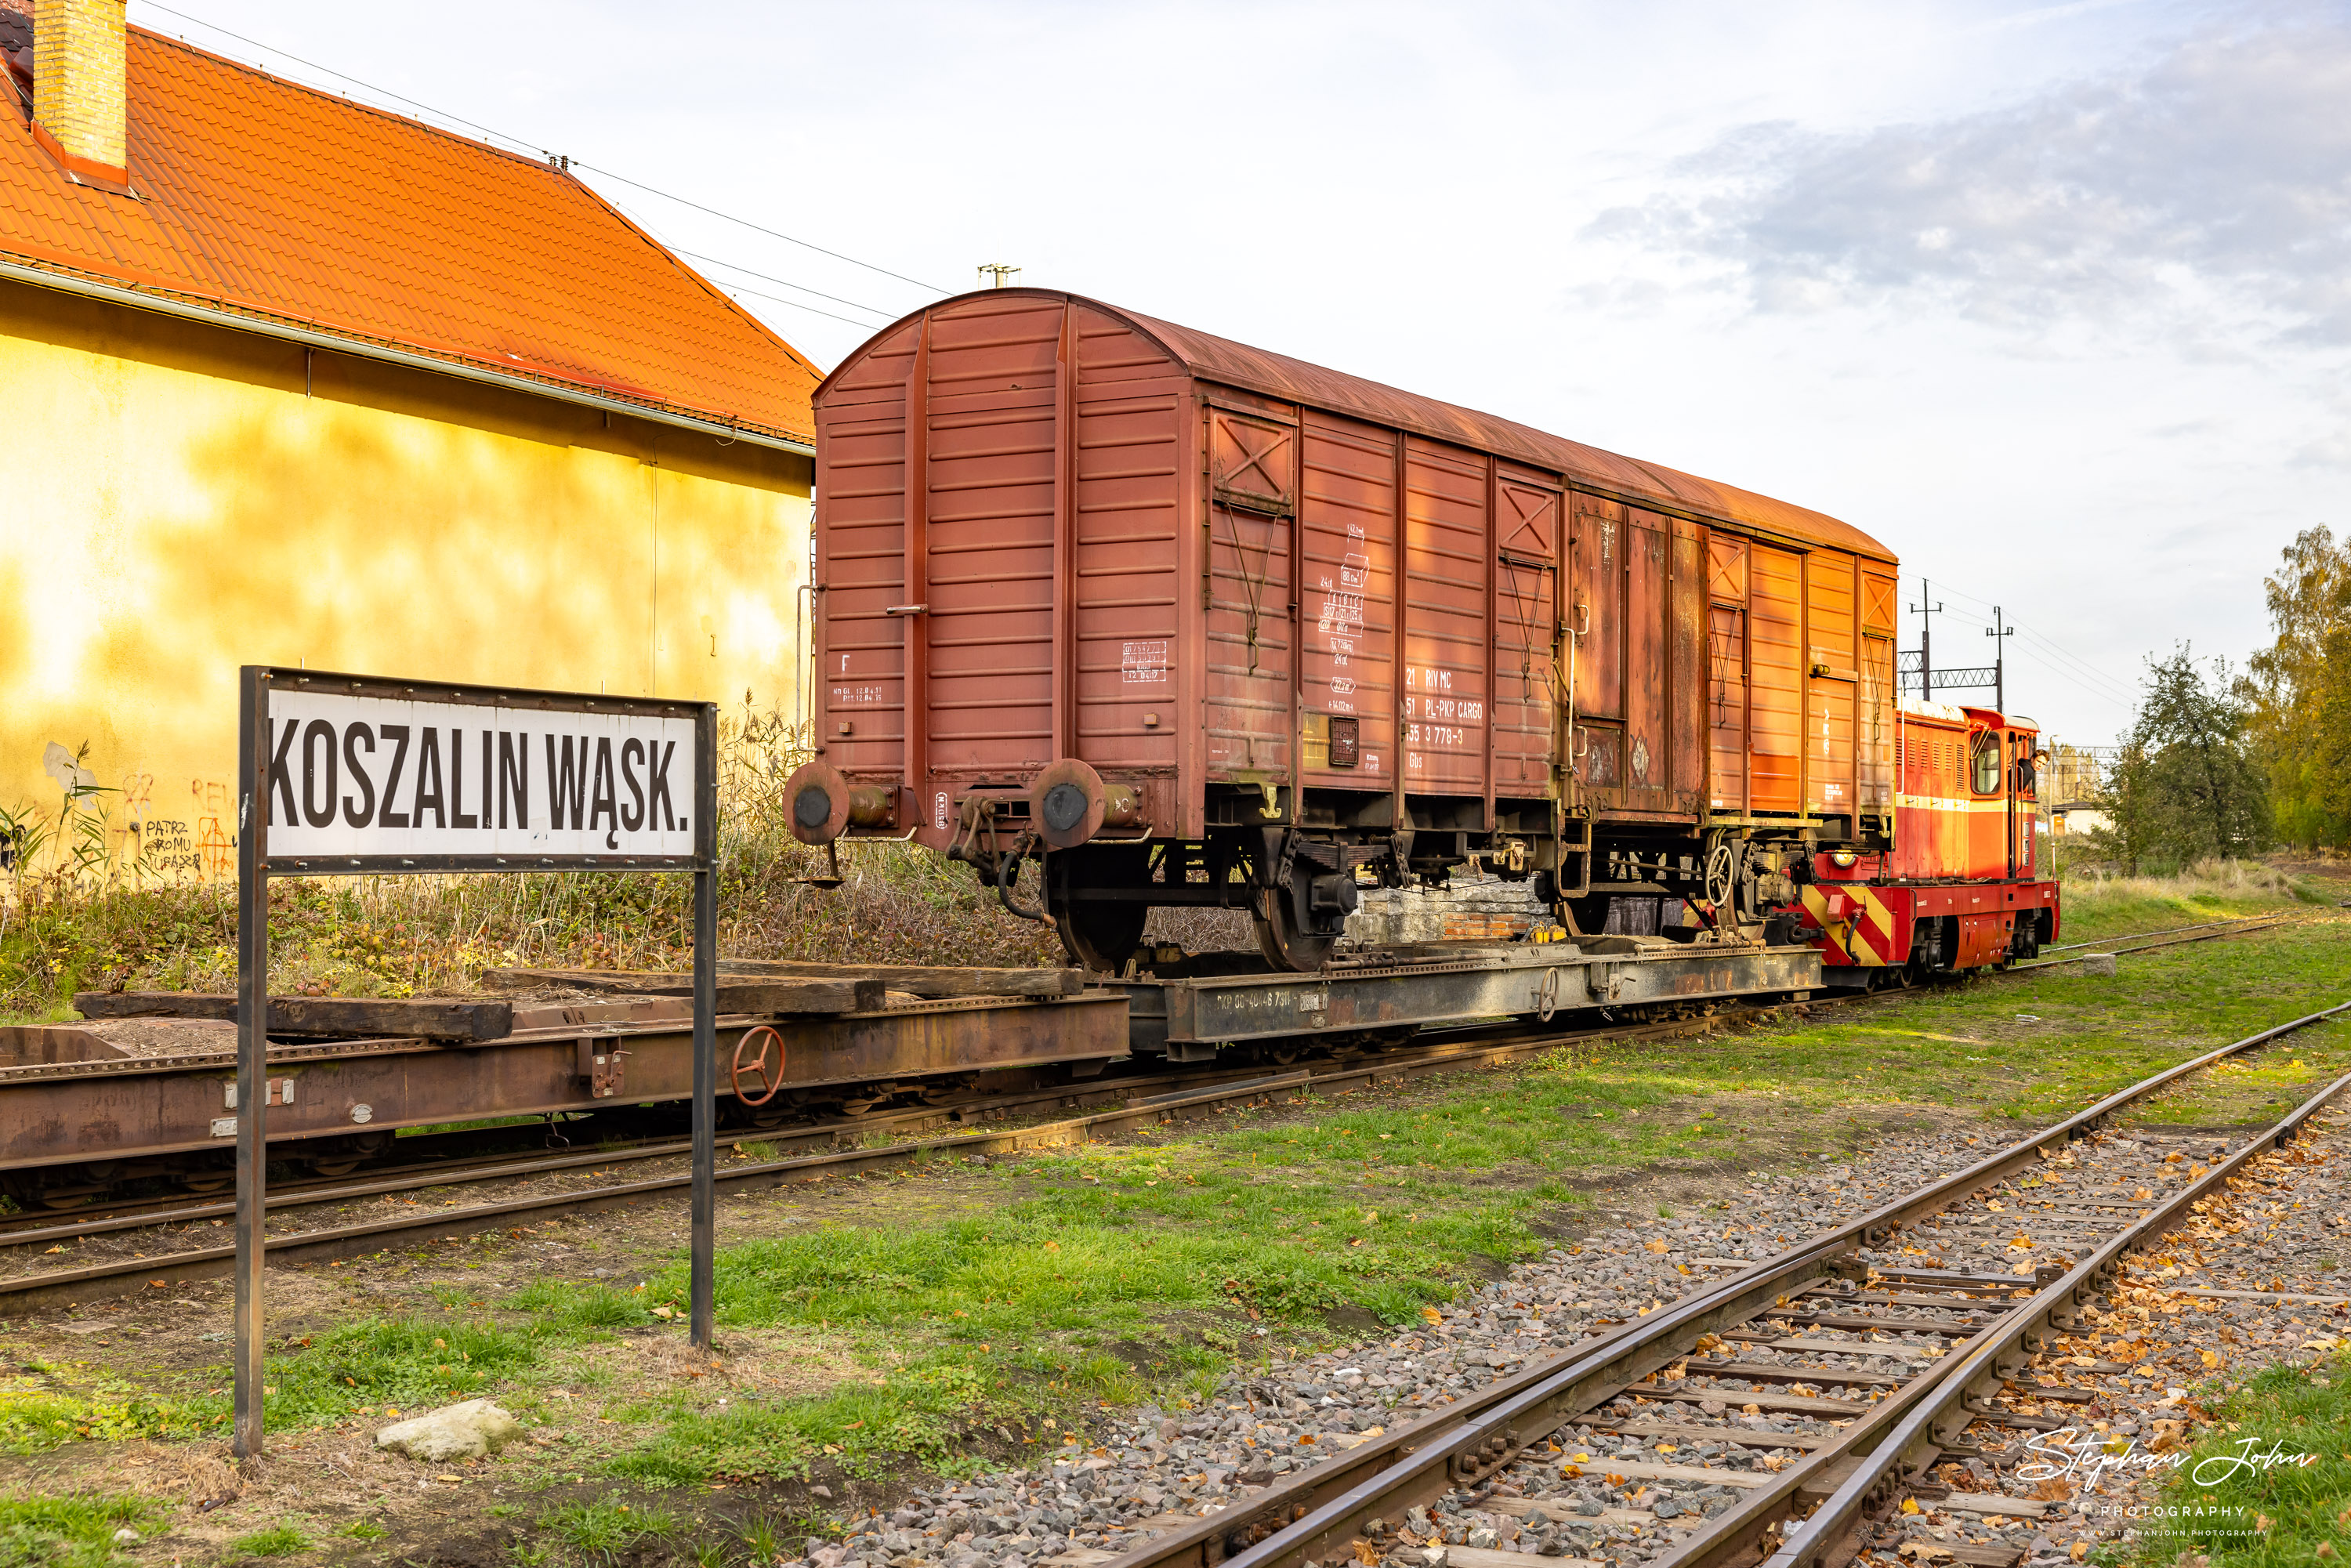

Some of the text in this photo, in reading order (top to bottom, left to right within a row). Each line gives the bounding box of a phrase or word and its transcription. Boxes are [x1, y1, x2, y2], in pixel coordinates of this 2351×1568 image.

[1407, 668, 1451, 689] 21 RIV MC
[1407, 697, 1483, 719] 51 PL-PKP CARGO
[1425, 726, 1431, 742] 3
[1434, 727, 1463, 744] 778-3
[1409, 752, 1422, 768] Gbs
[268, 718, 688, 849] KOSZALIN WĄSK.
[147, 820, 188, 837] PATRZ
